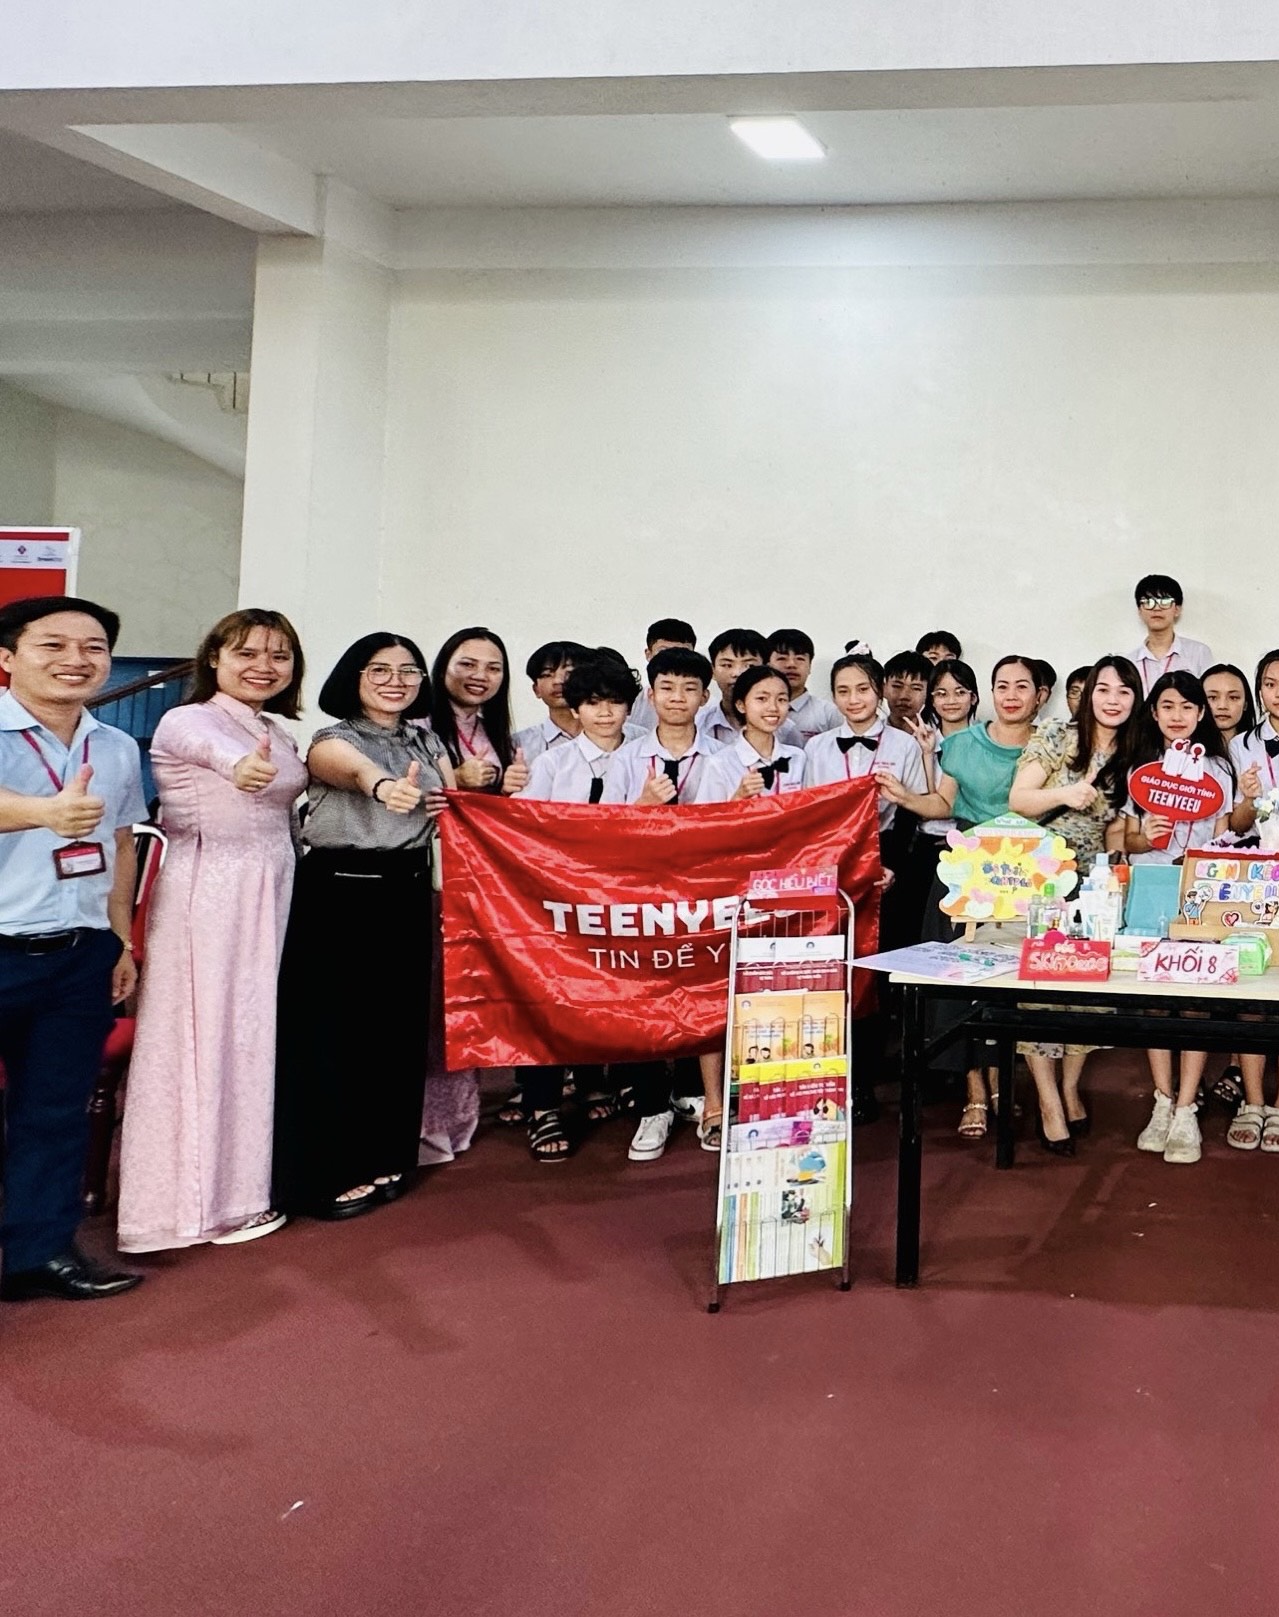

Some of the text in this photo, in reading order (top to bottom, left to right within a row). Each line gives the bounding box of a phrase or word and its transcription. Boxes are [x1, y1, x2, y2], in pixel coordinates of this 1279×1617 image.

[1141, 775, 1160, 786] GIÁO
[1197, 786, 1216, 799] TÍNH
[1148, 788, 1201, 813] TEENYEEU
[543, 895, 798, 937] TEENYEE
[588, 947, 640, 969] TIN
[651, 942, 695, 969] ĐỂ
[1154, 946, 1218, 974] KHỐI 8
